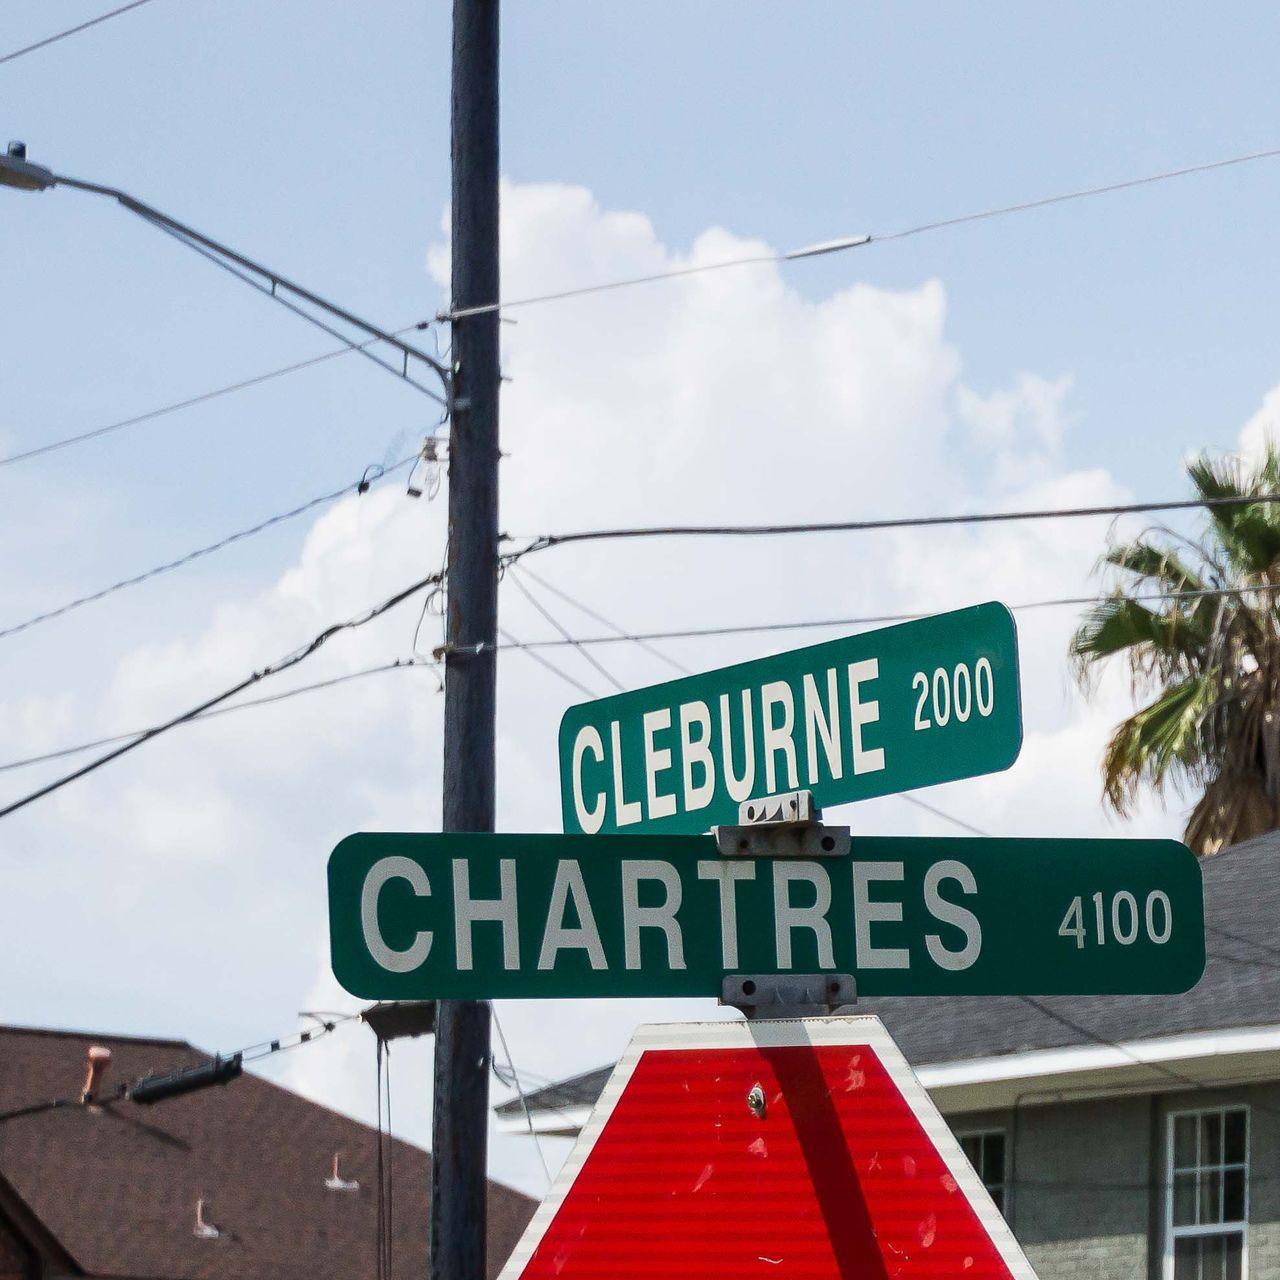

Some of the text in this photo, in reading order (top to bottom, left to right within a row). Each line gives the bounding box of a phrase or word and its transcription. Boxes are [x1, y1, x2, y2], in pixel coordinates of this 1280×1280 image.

[572, 656, 994, 835] CLEBURNE 2000
[359, 856, 1173, 972] CHARTRES 4100
